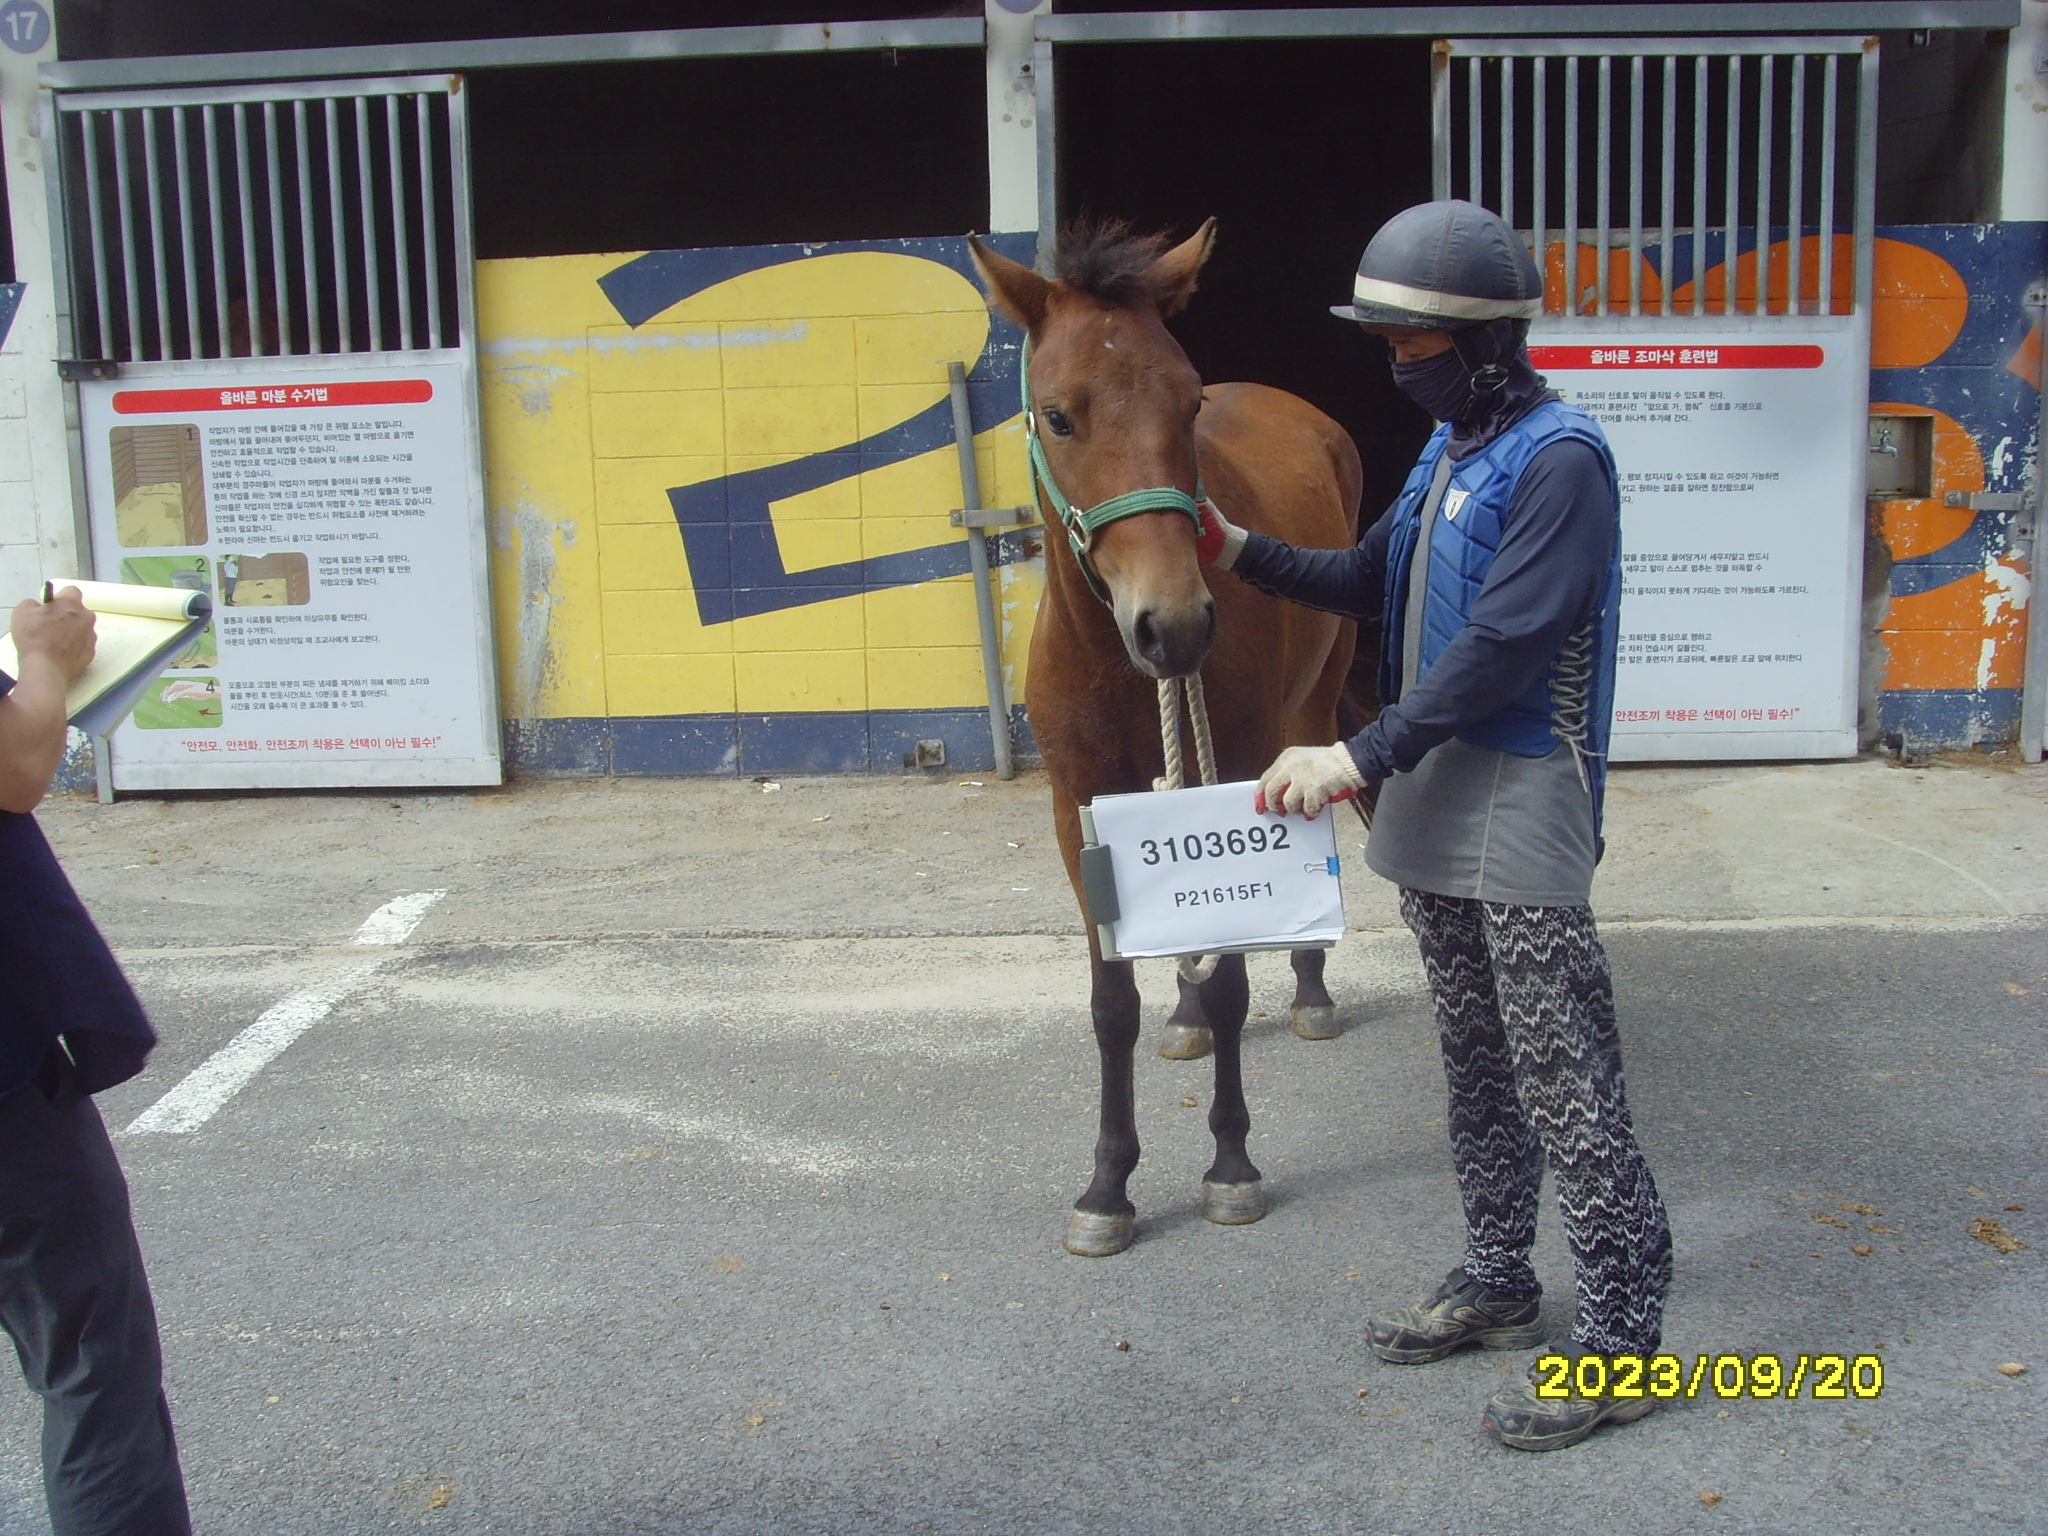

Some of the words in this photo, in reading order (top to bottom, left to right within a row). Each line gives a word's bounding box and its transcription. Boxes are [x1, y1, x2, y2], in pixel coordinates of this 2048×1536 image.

[6, 11, 38, 41] 17
[1591, 350, 1630, 364] 올바른
[1635, 350, 1675, 364] 조마삭
[1680, 350, 1719, 364] 훈련법
[221, 390, 257, 406] 올바른
[262, 390, 286, 404] 마분
[291, 388, 329, 403] 수거법
[185, 427, 193, 441] 1
[196, 558, 206, 572] 2
[205, 680, 216, 694] 4
[1616, 710, 1662, 722] 안전조끼
[1665, 710, 1699, 722] 착용은
[1704, 710, 1738, 720] 선택이
[1741, 710, 1763, 720] 아닌
[227, 740, 262, 752] 안전화,
[266, 740, 310, 751] 안전조끼
[313, 739, 345, 750] 착용은
[350, 738, 382, 749] 선택이
[385, 739, 407, 749] 아닌
[1140, 823, 1291, 866] 3103692
[1174, 882, 1274, 908] P21615F1
